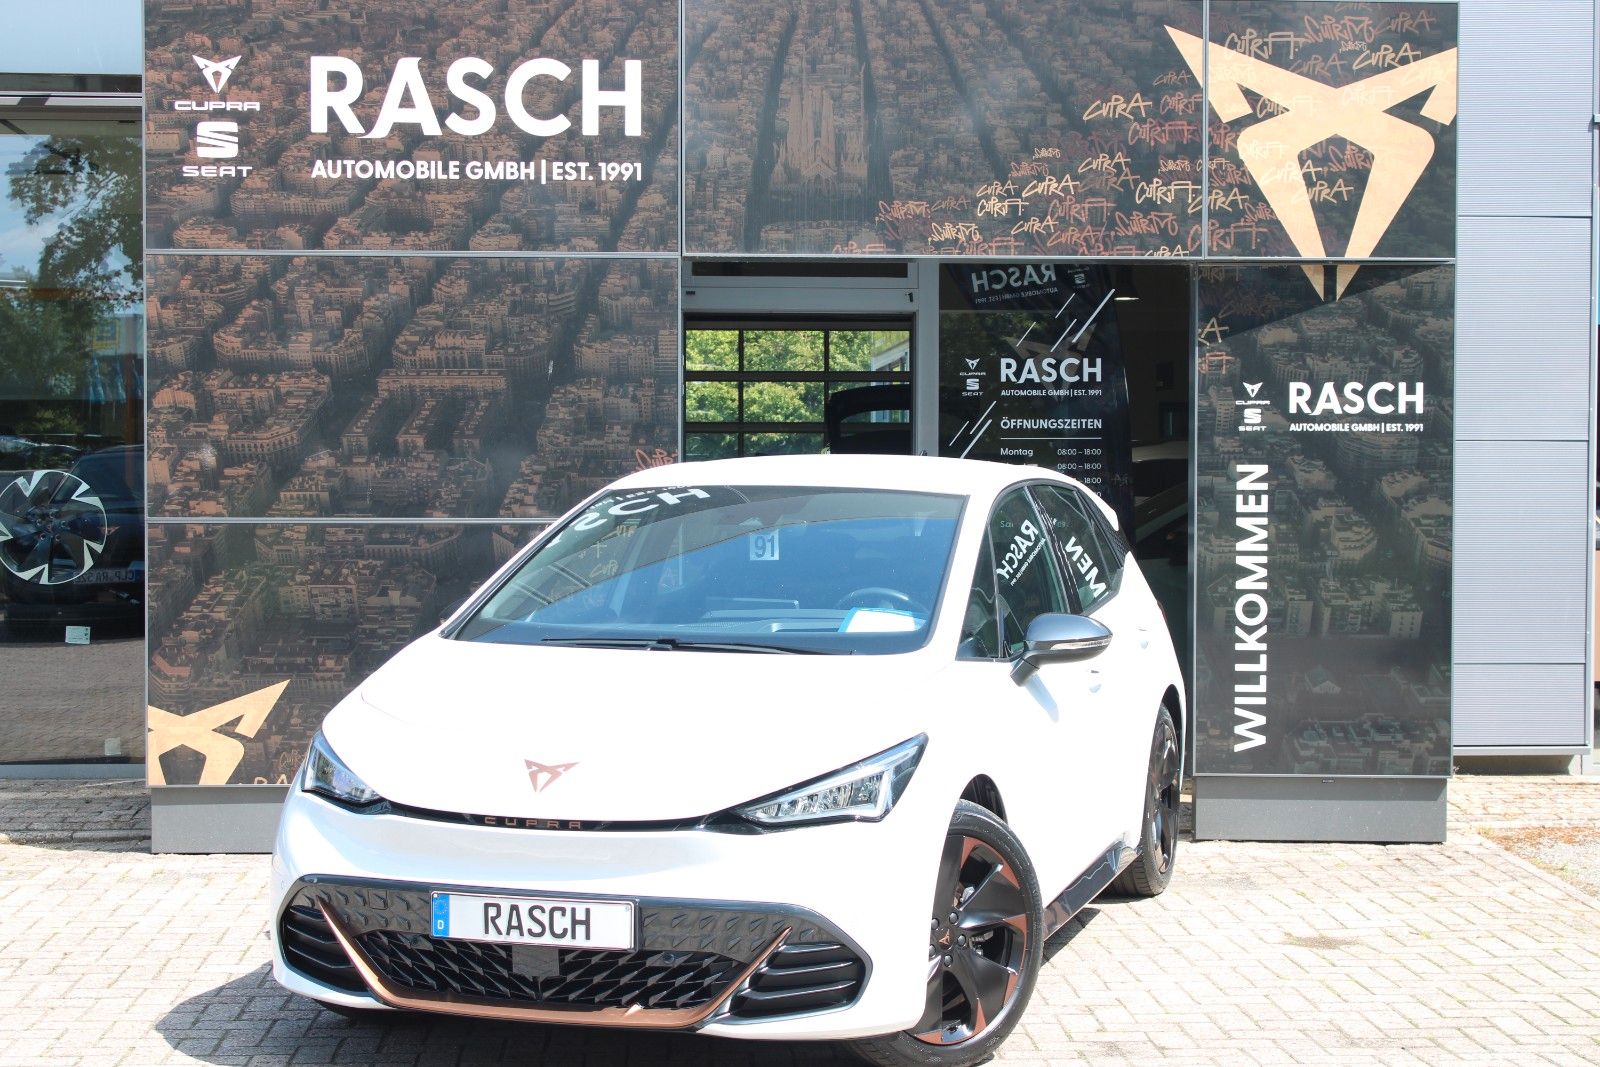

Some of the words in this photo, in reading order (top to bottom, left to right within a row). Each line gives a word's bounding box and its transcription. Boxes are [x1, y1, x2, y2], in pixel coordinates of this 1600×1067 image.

[1352, 42, 1422, 71] CUPRA
[174, 100, 261, 111] CUPRA
[311, 56, 641, 139] RASCH
[1082, 92, 1153, 121] CUPRA
[182, 165, 253, 178] SEAT
[311, 160, 460, 181] AUTOMOBILE
[466, 160, 535, 181] GMBH
[553, 162, 594, 181] EST.
[599, 162, 642, 181] 1991
[1078, 152, 1131, 173] CUPRA
[976, 180, 1018, 197] CUPRA
[1022, 174, 1080, 198] CUPRA
[1135, 178, 1202, 204] CUPRA
[978, 196, 1029, 217] CUPRA
[1011, 216, 1059, 235] CUPRA
[1001, 358, 1102, 384] RASCH
[1289, 381, 1424, 416] RASCH
[1001, 416, 1102, 429] ÖFFNUNGSZEITEN
[1289, 422, 1350, 432] AUTOMOBILE
[1351, 423, 1380, 432] GMBH
[1405, 423, 1424, 432] 1991
[1001, 447, 1034, 457] Montag
[1057, 448, 1077, 456] 08:00
[754, 535, 776, 559] 91
[1233, 464, 1269, 753] WILLKOMMEN
[484, 816, 582, 830] CUPRA
[437, 919, 444, 930] D
[483, 902, 592, 941] RASCH
